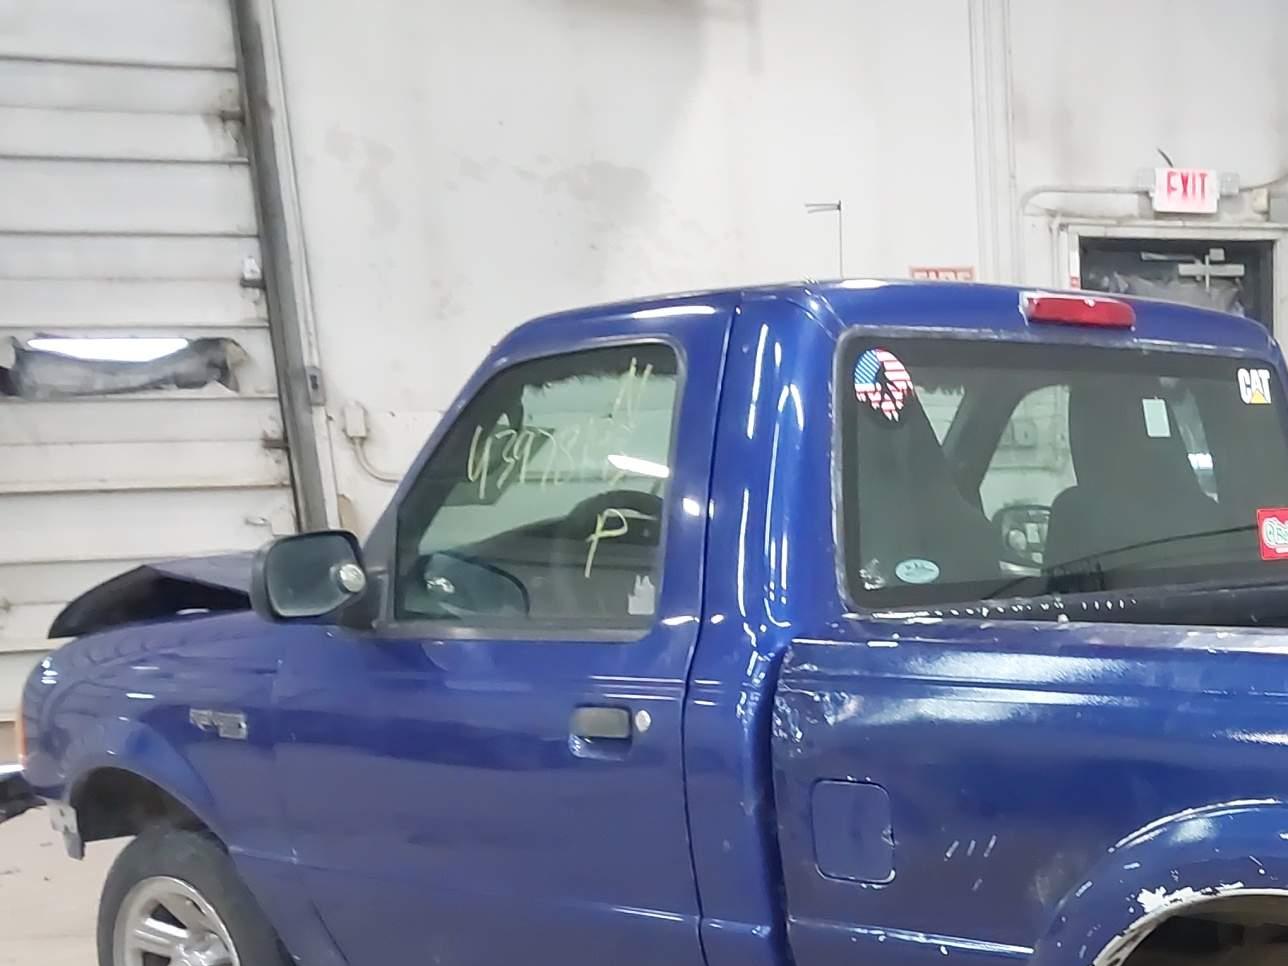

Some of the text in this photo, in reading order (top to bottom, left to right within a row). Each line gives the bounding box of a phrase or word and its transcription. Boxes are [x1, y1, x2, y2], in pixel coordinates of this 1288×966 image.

[1166, 170, 1208, 201] EXIT
[1237, 367, 1272, 405] CAT
[467, 416, 632, 500] 4397819
[585, 508, 629, 579] P
